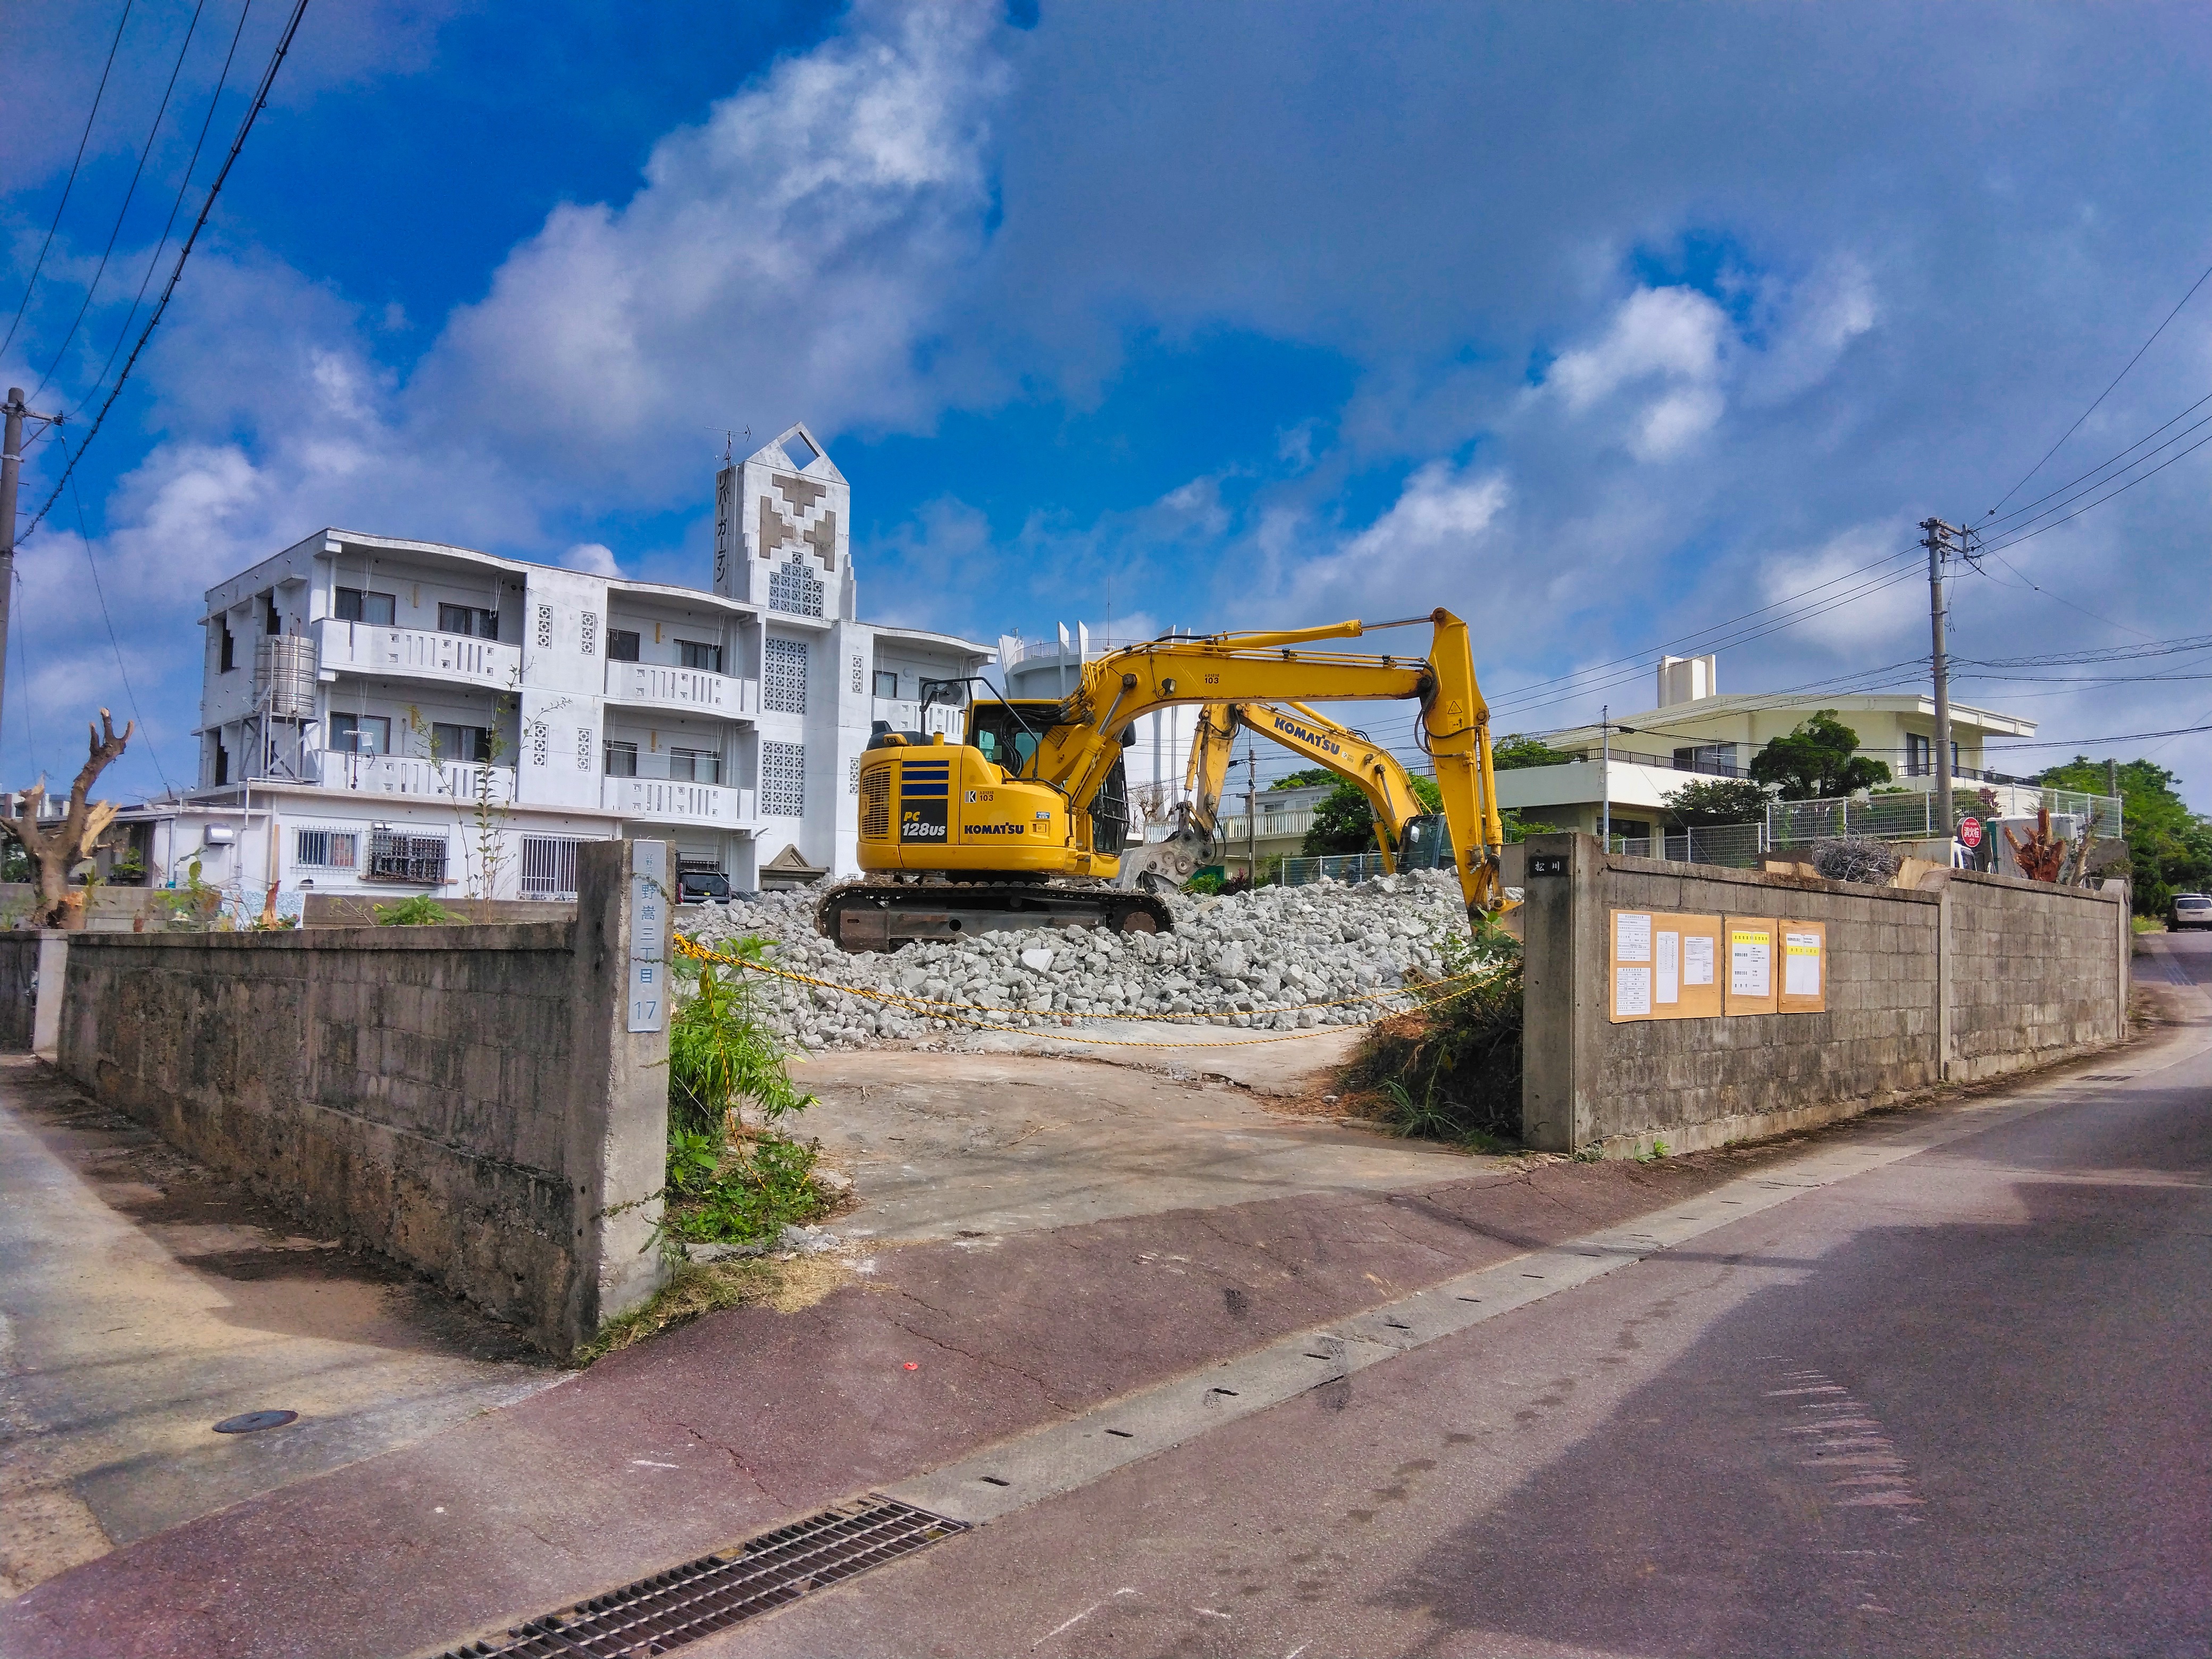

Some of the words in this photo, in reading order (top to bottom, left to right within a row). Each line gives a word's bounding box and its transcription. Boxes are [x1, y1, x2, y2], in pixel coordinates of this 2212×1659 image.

[716, 475, 729, 583] リバーガーデン
[1274, 717, 1340, 755] KOMATSU
[903, 811, 920, 822] PC
[902, 823, 945, 836] 128US
[964, 822, 1024, 834] KOMATSU
[1964, 827, 1980, 838] 消火栓
[1535, 861, 1560, 872] 松川
[640, 884, 656, 984] 野嵩三丁目
[634, 1001, 657, 1020] 17
